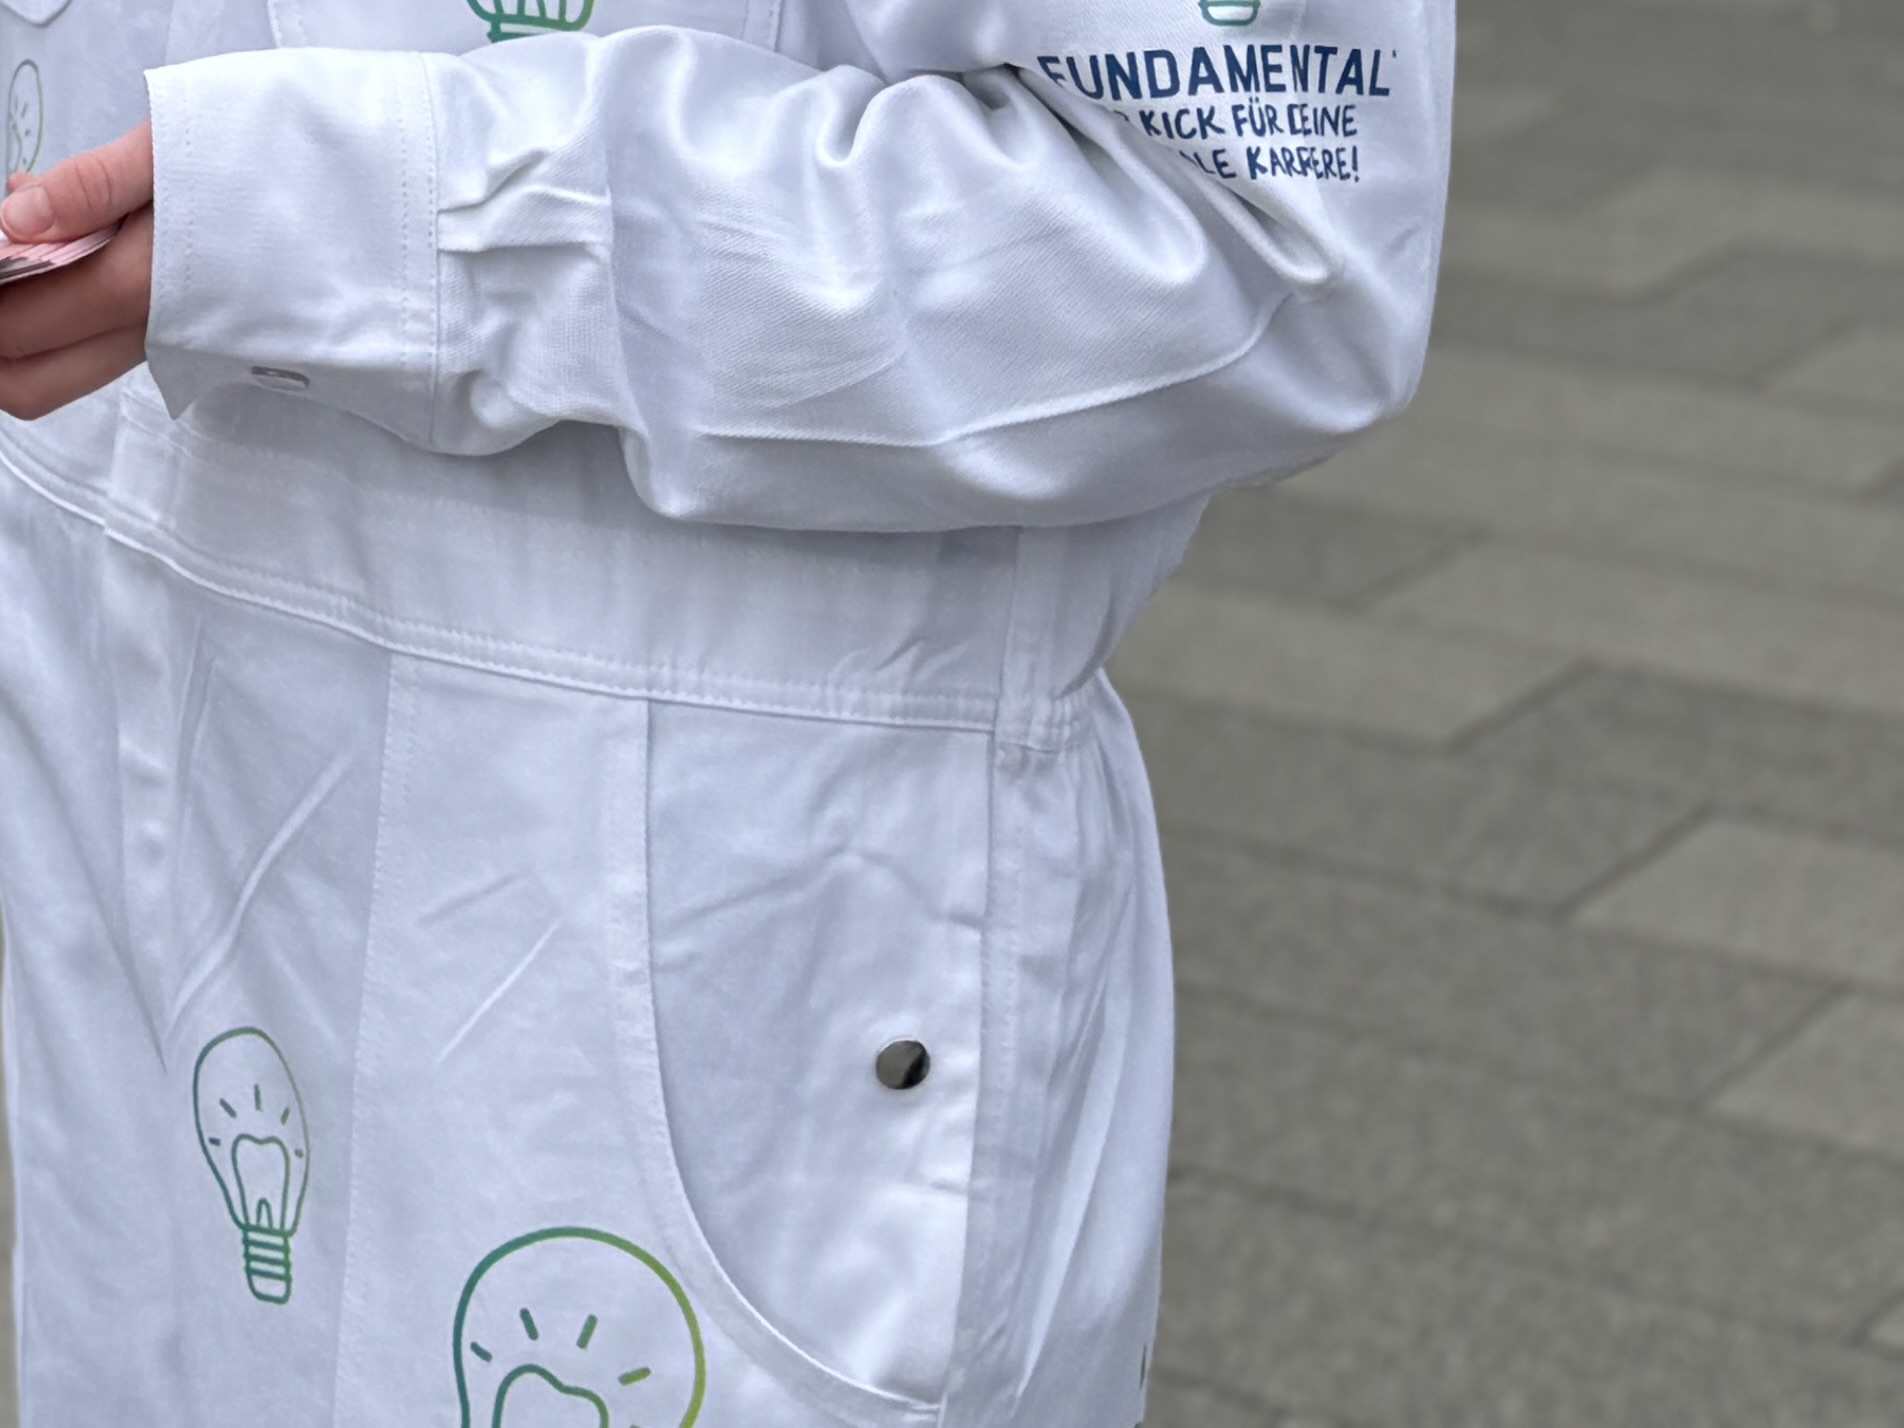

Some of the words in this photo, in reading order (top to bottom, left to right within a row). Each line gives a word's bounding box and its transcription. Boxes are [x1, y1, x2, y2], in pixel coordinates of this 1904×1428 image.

[1037, 44, 1390, 101] FUNDAMENTAL
[1138, 105, 1225, 139] KICK
[1232, 97, 1284, 137] FÜR
